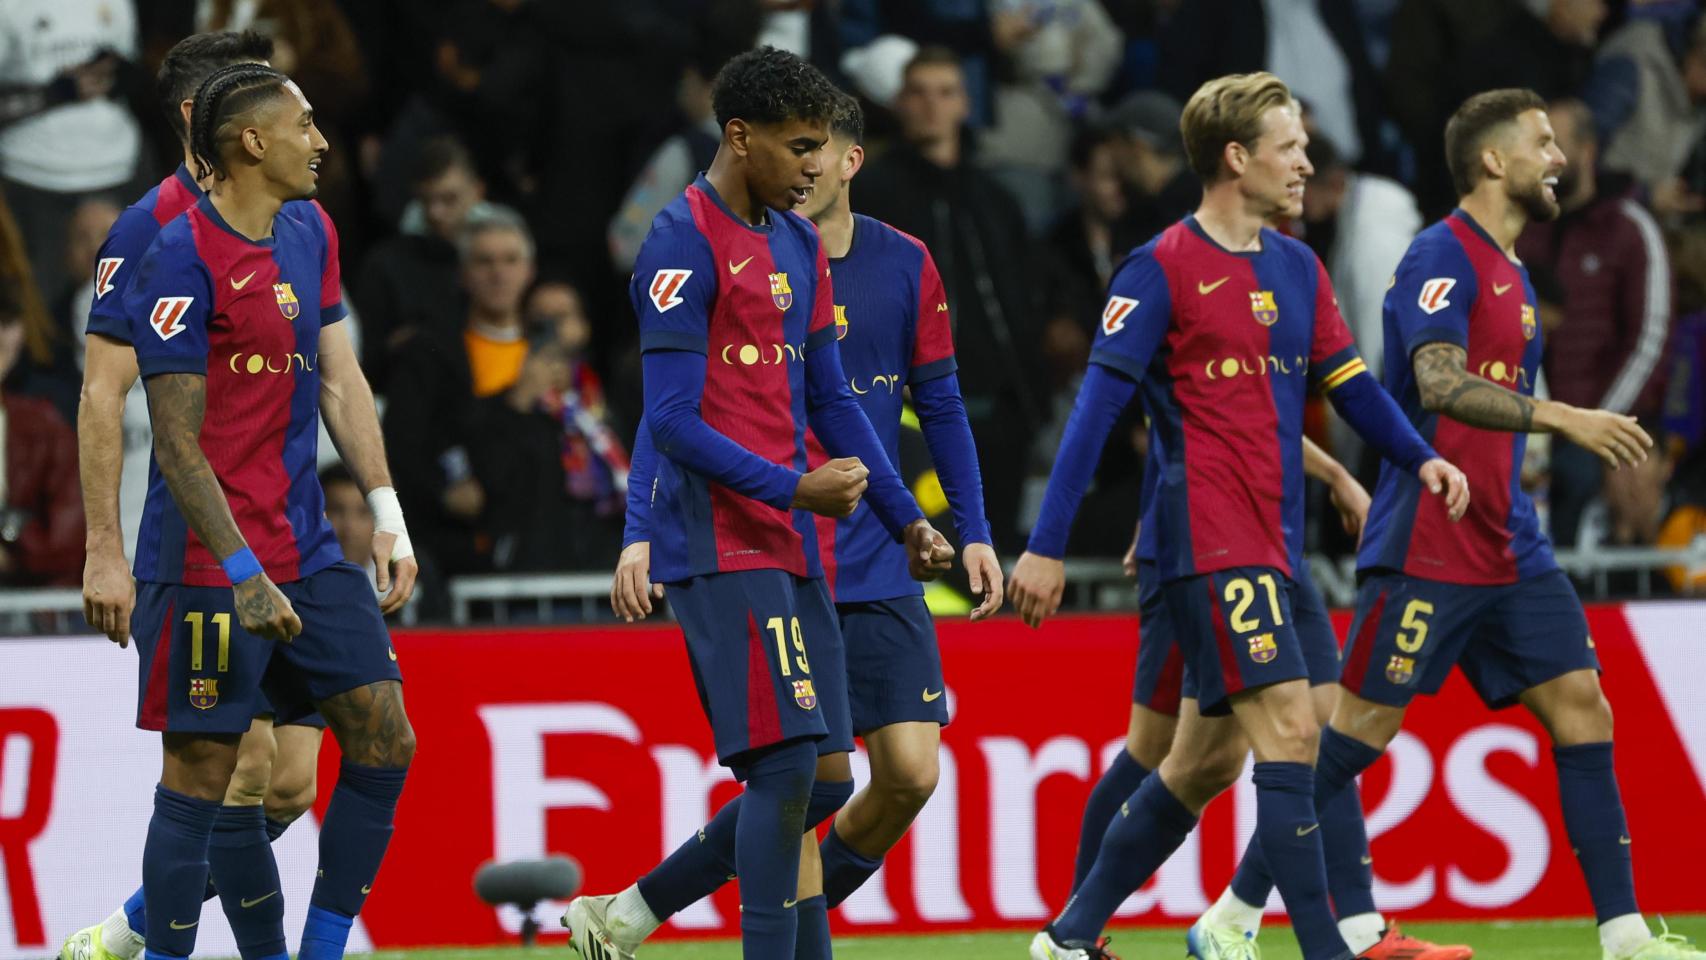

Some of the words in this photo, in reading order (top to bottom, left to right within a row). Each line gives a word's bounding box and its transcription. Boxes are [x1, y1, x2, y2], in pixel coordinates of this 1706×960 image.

[1224, 574, 1284, 634] 21
[1396, 599, 1434, 653] 5
[184, 612, 231, 672] 11
[766, 616, 810, 676] 19
[477, 685, 1551, 933] Eires
